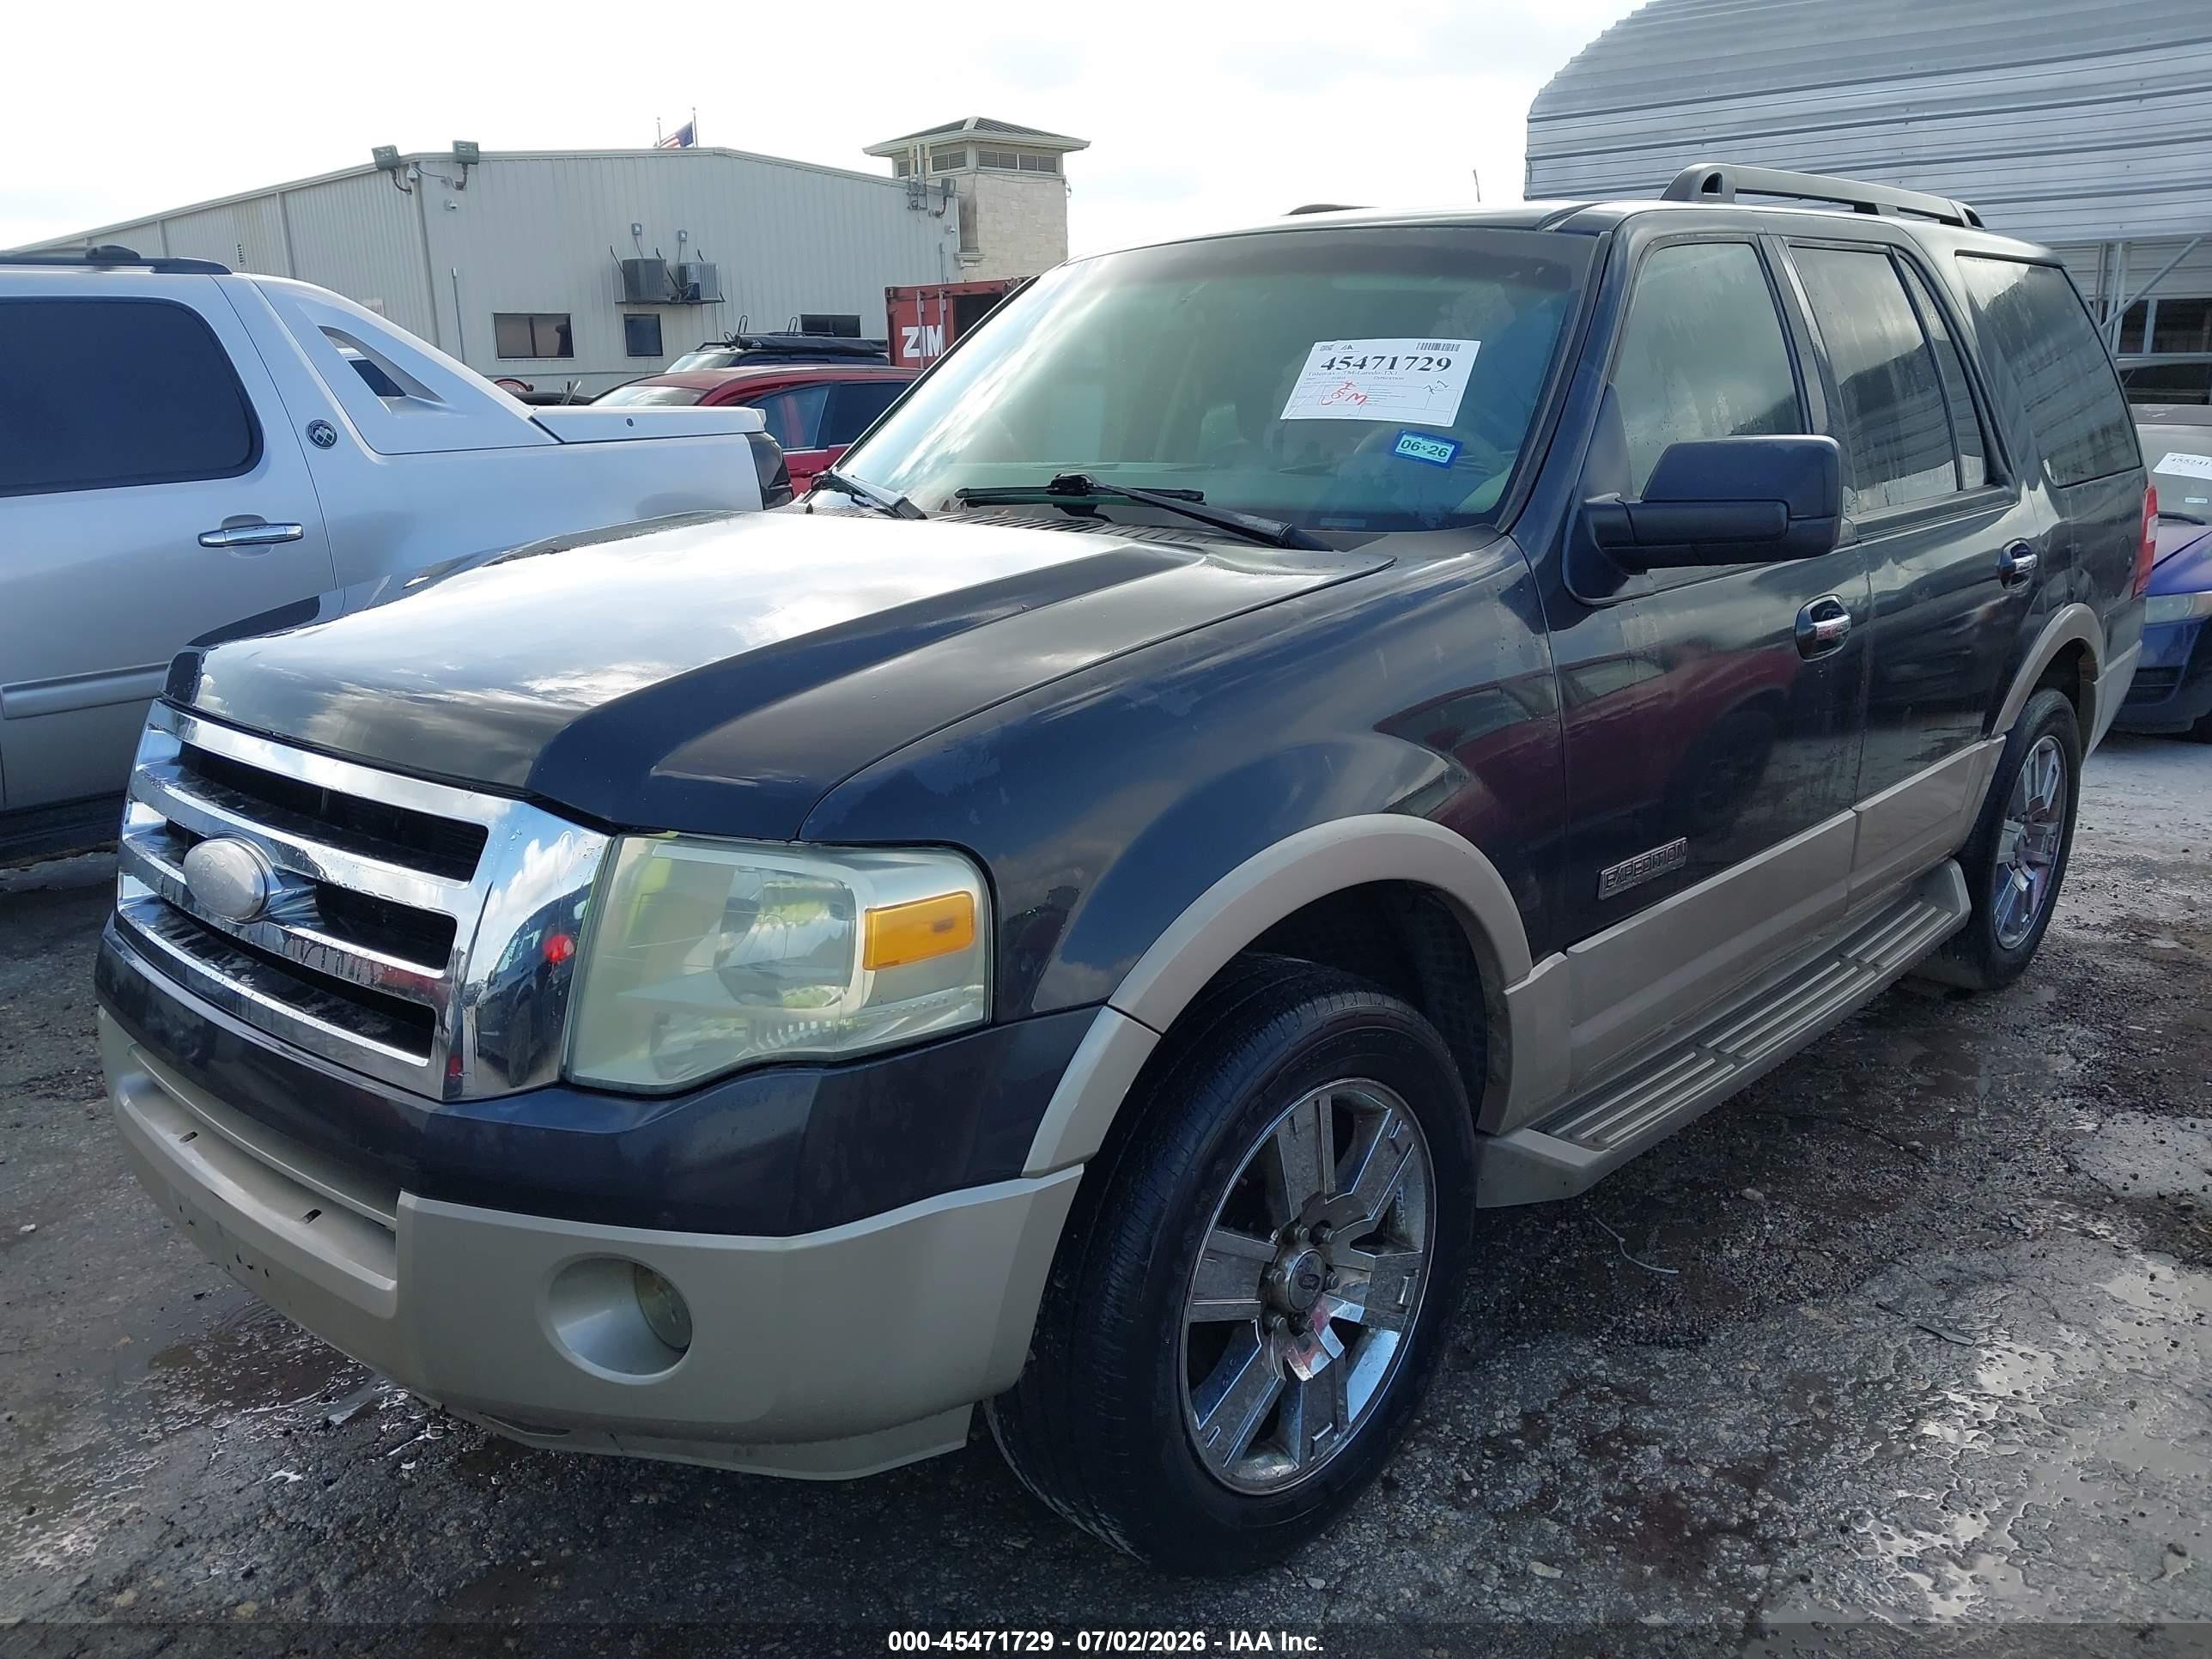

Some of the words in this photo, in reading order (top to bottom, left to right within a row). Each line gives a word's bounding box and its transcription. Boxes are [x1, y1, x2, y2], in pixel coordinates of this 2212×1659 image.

[902, 325, 944, 358] ZIM
[1320, 355, 1453, 372] 45471729
[1603, 840, 1688, 891] EXPEDITION
